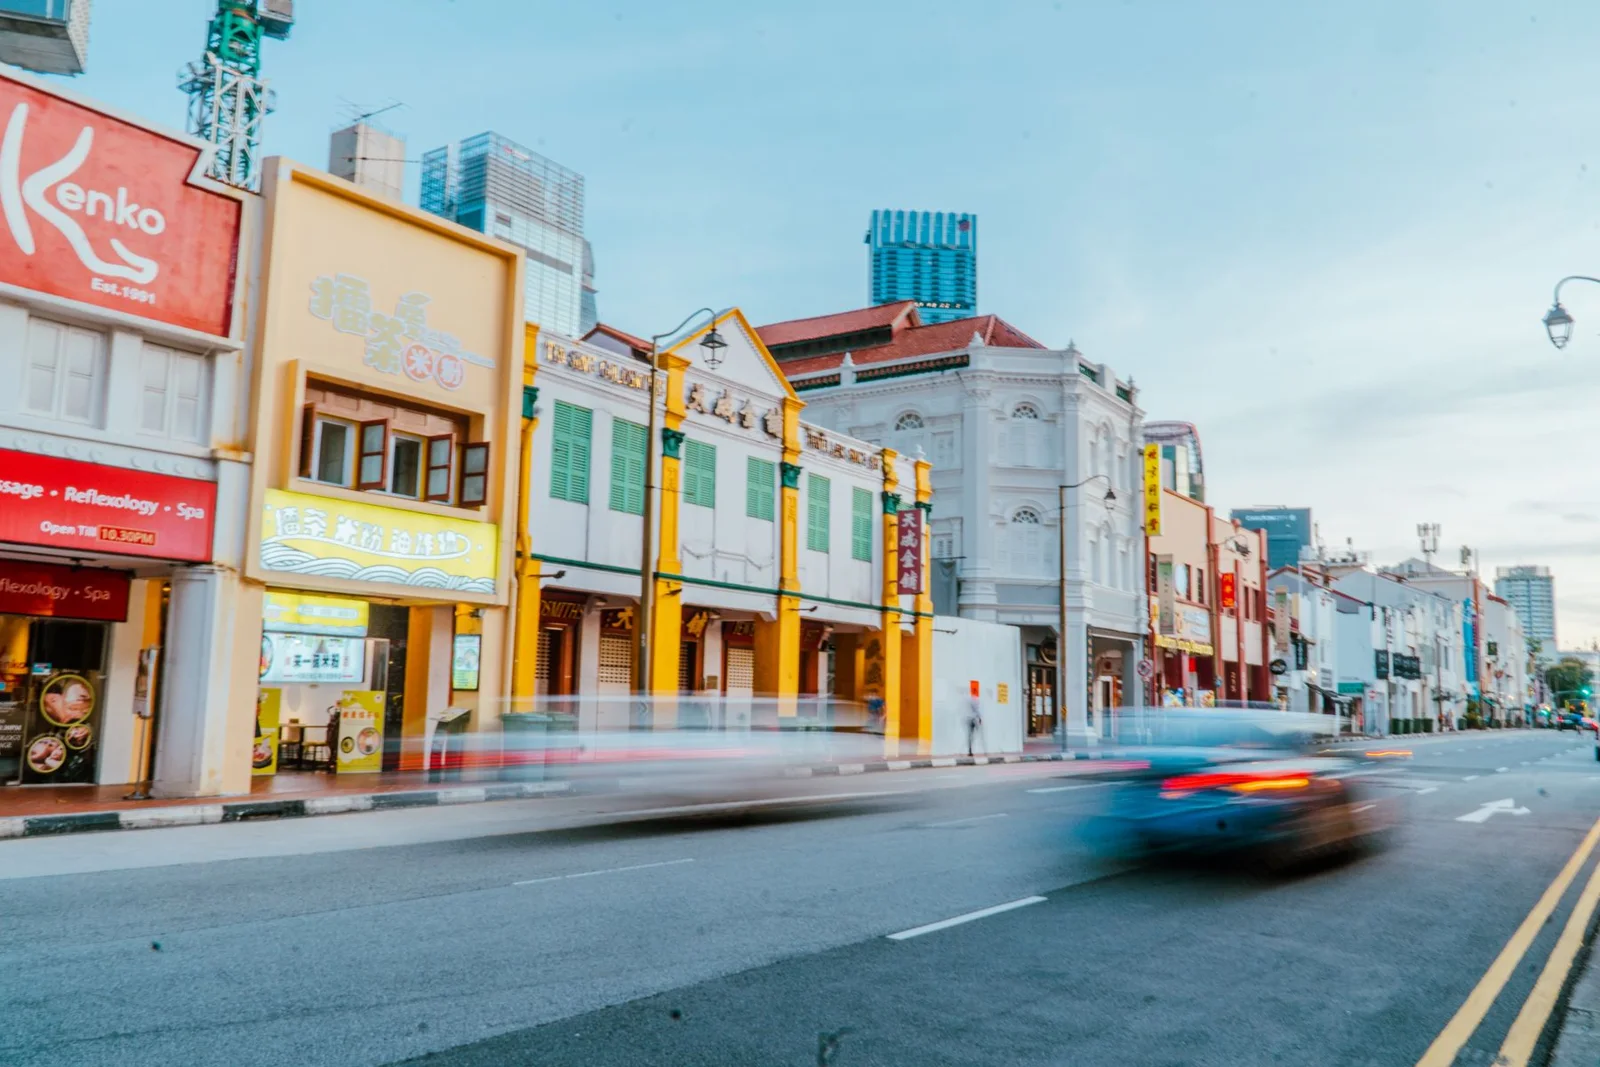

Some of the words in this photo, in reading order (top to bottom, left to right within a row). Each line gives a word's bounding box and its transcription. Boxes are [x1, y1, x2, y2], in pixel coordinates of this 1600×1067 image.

[0, 103, 165, 284] Kenko
[64, 487, 158, 516] Reflexology
[176, 503, 204, 520] Spa
[40, 521, 76, 535] Open
[102, 528, 154, 545] 10.30PM
[84, 586, 111, 602] Spa
